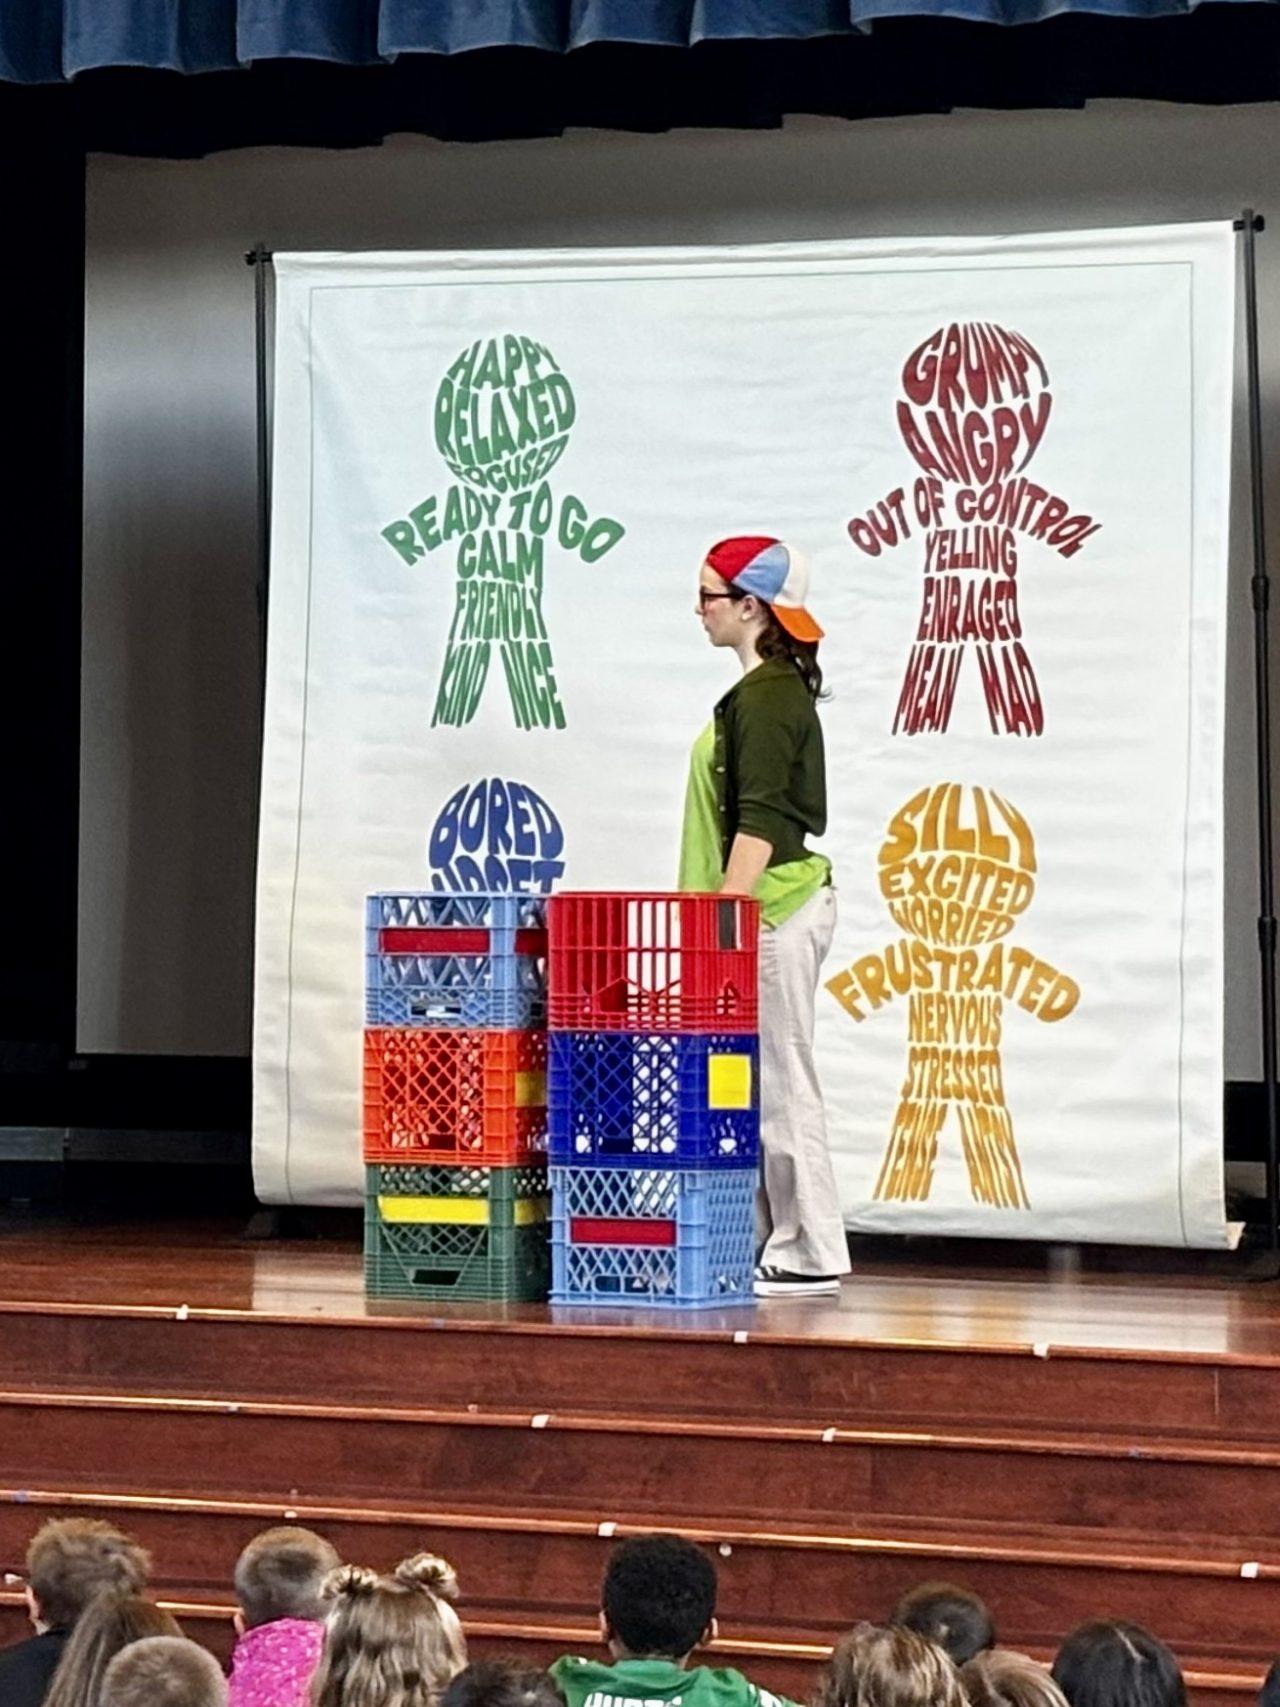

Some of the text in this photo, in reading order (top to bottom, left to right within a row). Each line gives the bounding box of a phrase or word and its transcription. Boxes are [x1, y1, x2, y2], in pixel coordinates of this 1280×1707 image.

[447, 334, 560, 390] HAPPY
[902, 322, 1049, 412] GRUMPY
[434, 373, 576, 465] RELAXED
[897, 392, 1052, 486] ANGRY
[445, 434, 570, 494] FOCUSED
[380, 480, 626, 567] READY TO GO
[847, 477, 1103, 559] OUT OF CONTROL
[924, 525, 1017, 578] YELLING
[457, 530, 544, 590] CALM
[449, 580, 548, 641] FRIENDLY
[917, 576, 1022, 642] ENRAGED
[431, 640, 567, 731] KIND NICE
[892, 641, 1044, 737] MEAN MAD
[428, 777, 564, 869] BORED
[878, 782, 1037, 873] SILLY
[878, 854, 1035, 915] EXCITED
[888, 898, 1015, 948] WORRIED
[824, 938, 1081, 1023] FRUSTRATED
[908, 992, 1003, 1047] NERVOUS
[901, 1046, 1005, 1106] STRESSED
[873, 1102, 1032, 1211] TENSE ANTSY
